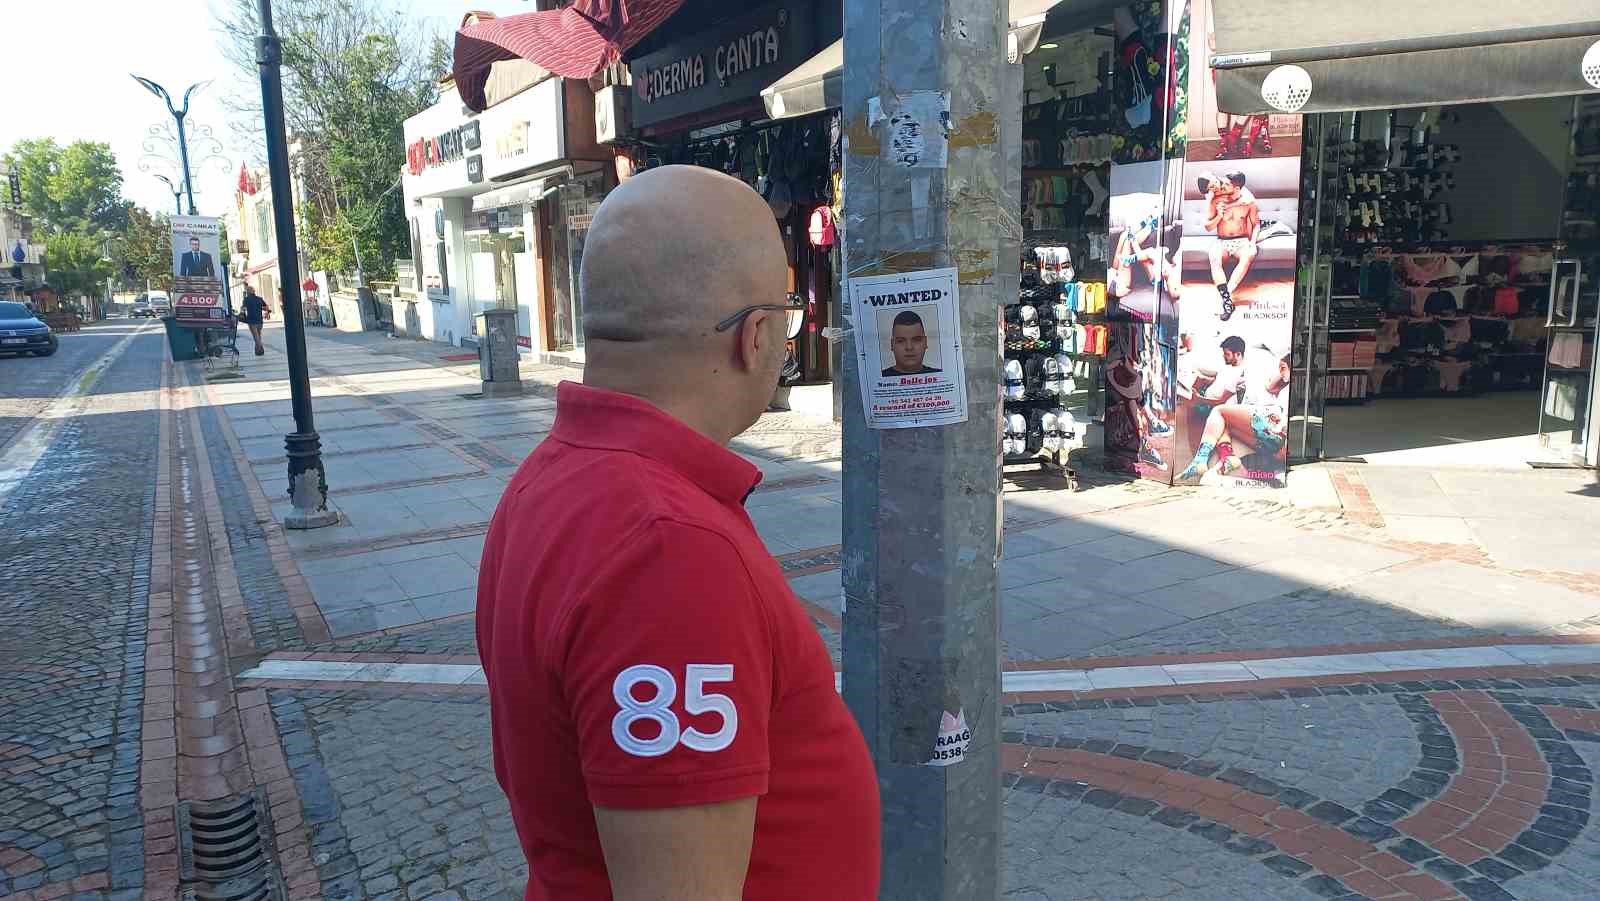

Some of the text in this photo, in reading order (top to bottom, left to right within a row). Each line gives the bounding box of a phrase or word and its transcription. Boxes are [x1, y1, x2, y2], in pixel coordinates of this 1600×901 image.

[654, 26, 779, 98] DERMA ÇANTA
[868, 289, 942, 307] WANTED
[879, 403, 906, 411] reward
[612, 664, 738, 756] 85
[933, 746, 962, 760] 0538
